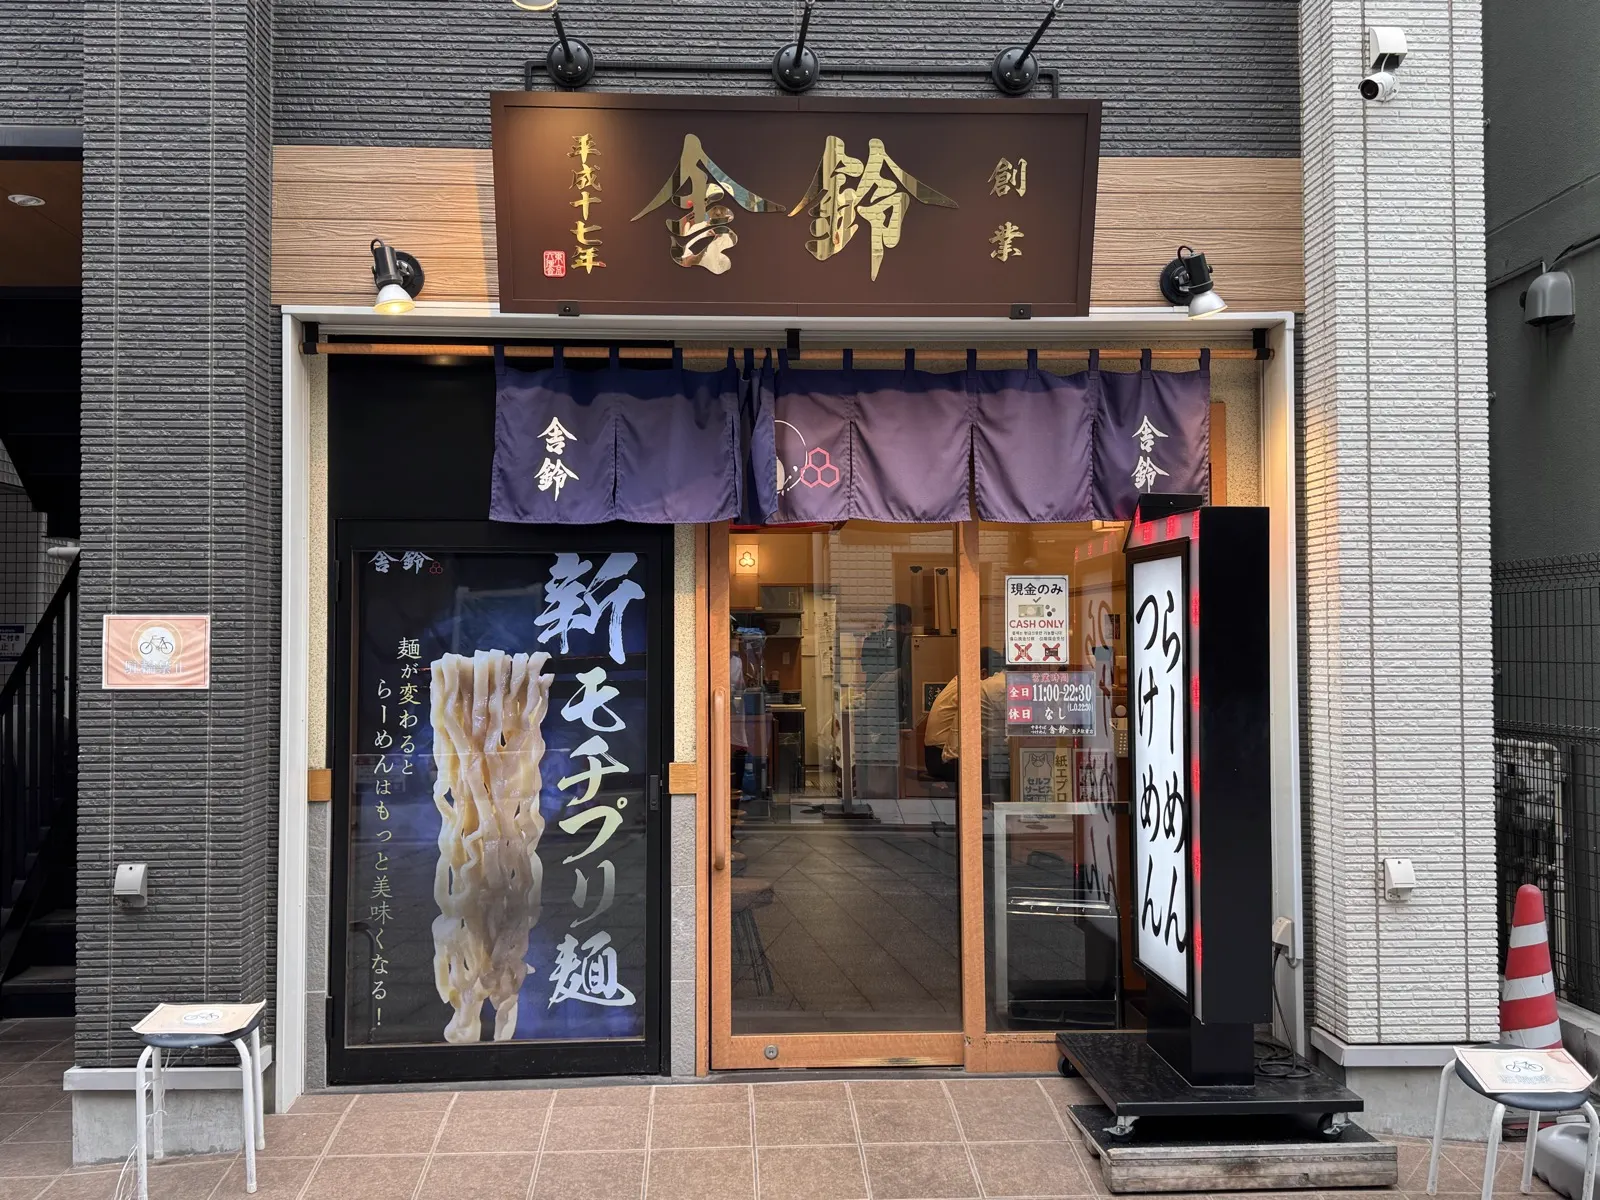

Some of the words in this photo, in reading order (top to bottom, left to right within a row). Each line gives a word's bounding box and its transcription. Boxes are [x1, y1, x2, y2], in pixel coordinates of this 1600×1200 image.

[566, 133, 607, 274] 平成十七年
[630, 133, 959, 281] 舎鈴
[989, 159, 1028, 263] 創業
[533, 416, 579, 502] 舎鈴
[1131, 415, 1170, 494] 舎鈴
[368, 551, 434, 574] 舎鈴
[1010, 582, 1064, 596] 現金のみ
[1009, 619, 1036, 628] CASH
[1038, 619, 1064, 628] ONLY
[396, 636, 423, 775] 麺が変わると
[1008, 708, 1031, 720] 休日
[1044, 706, 1066, 721] なし
[1009, 686, 1029, 698] 全日
[533, 552, 646, 1009] 新モチプリ麺
[1027, 777, 1051, 786] セルフ
[1055, 754, 1068, 802] 紙エプロ
[1136, 594, 1160, 938] つけめん
[1161, 588, 1188, 954] らーめん
